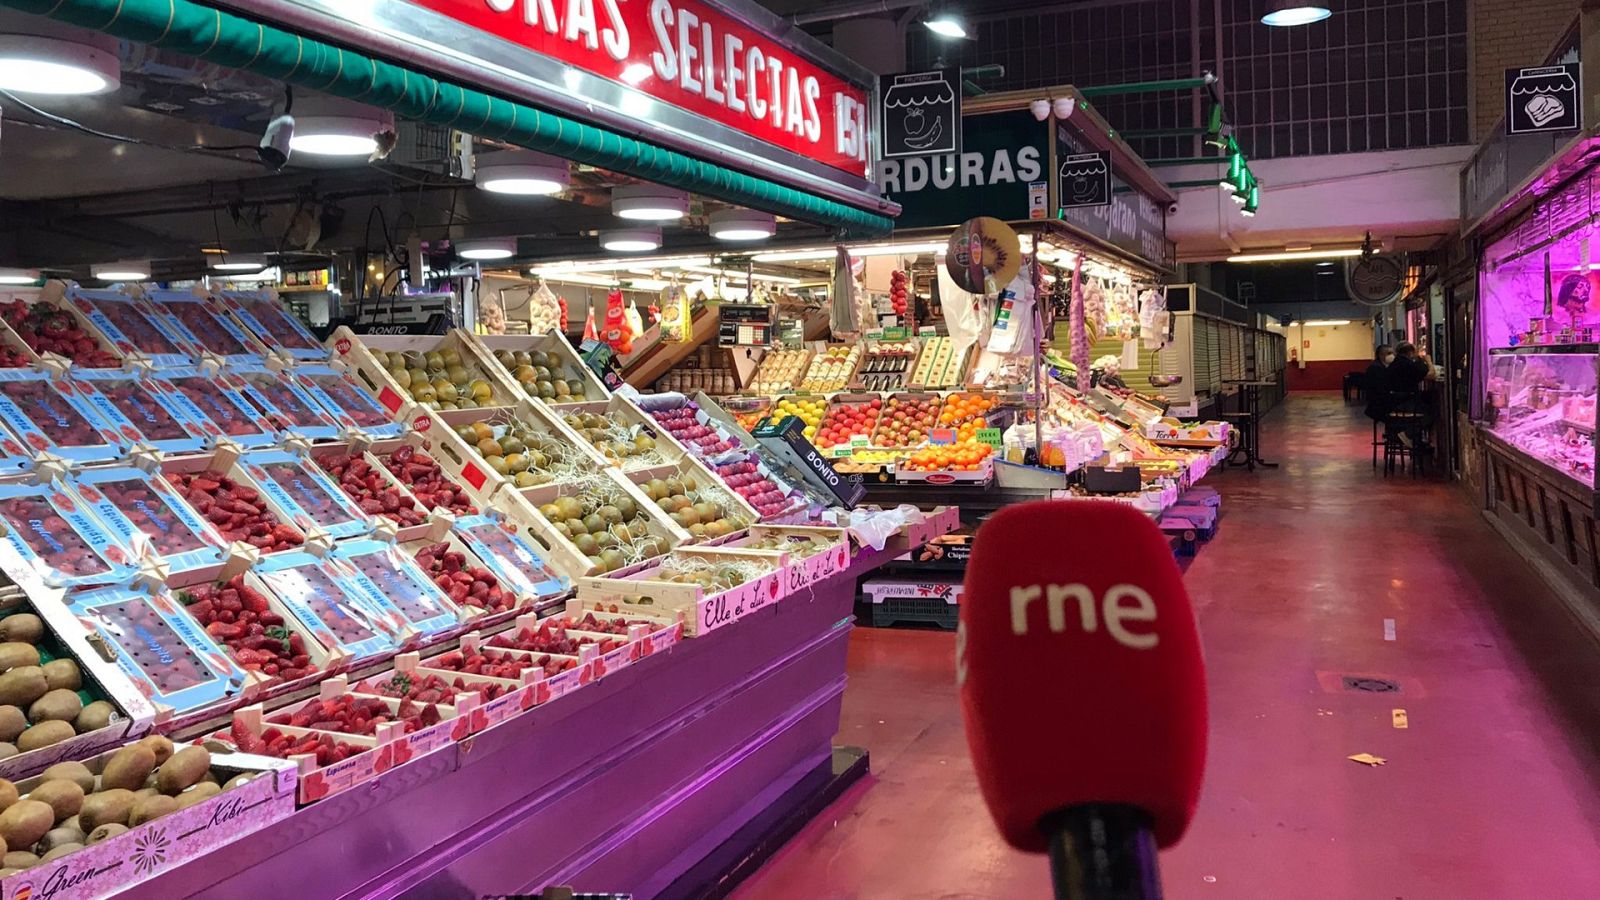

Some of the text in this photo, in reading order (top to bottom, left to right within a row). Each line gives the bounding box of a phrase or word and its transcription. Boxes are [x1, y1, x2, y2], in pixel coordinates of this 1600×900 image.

[648, 0, 822, 143] SELECTAS
[368, 325, 408, 335] BONITO
[806, 451, 840, 487] BONITO
[70, 514, 108, 546] Espinosa
[99, 504, 133, 537] Espinosa
[704, 579, 766, 629] Elle et Lui
[1009, 582, 1160, 649] rne
[410, 729, 435, 743] Espinosa
[326, 760, 357, 777] Espinosa
[41, 864, 97, 900] Green
